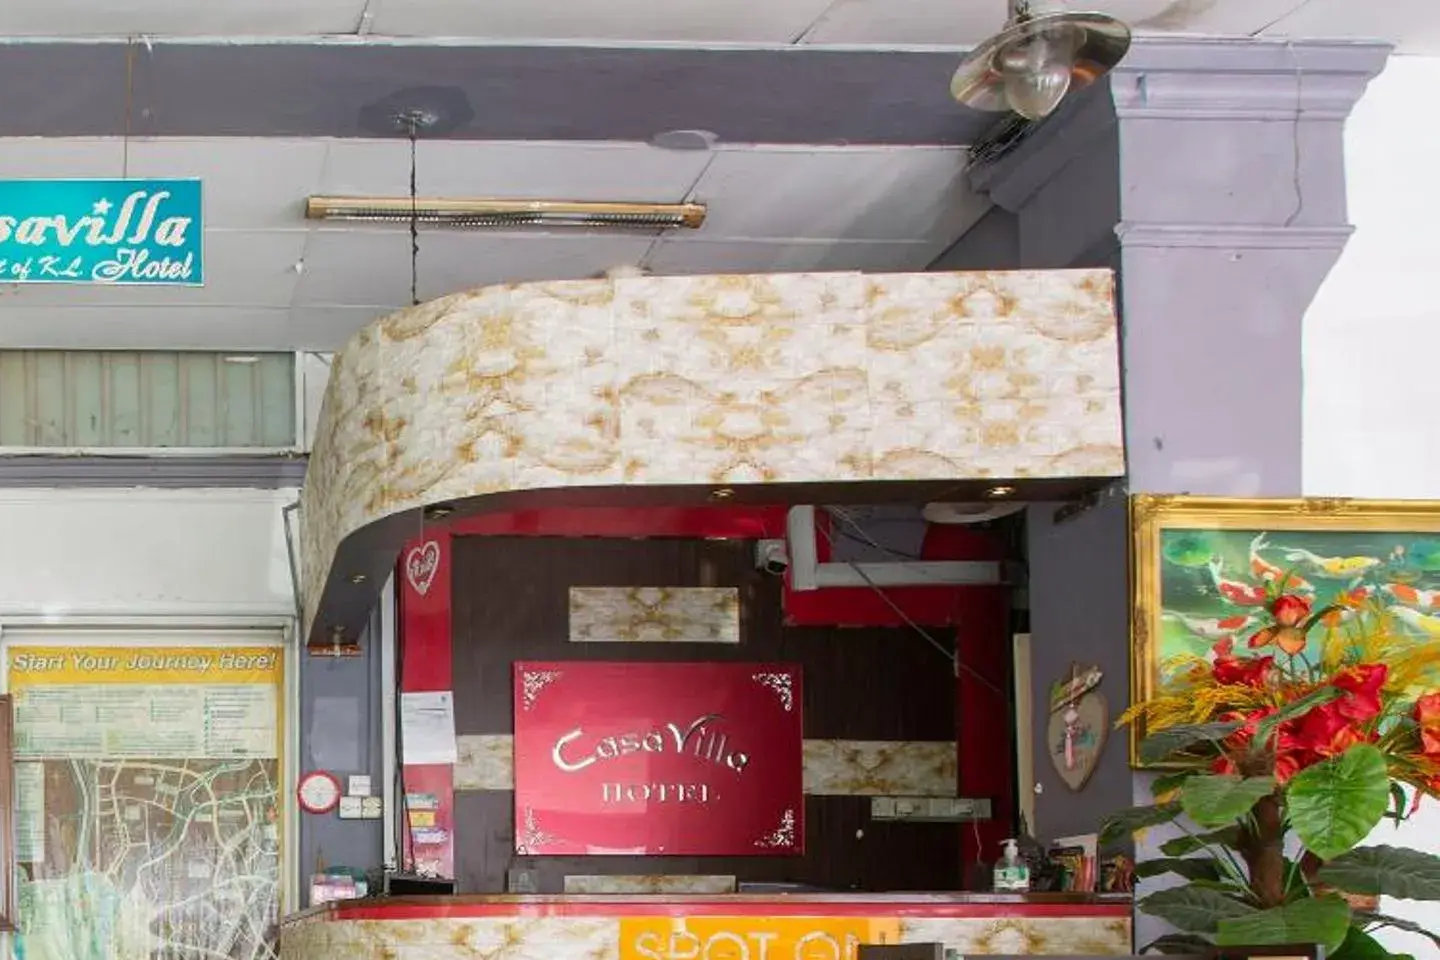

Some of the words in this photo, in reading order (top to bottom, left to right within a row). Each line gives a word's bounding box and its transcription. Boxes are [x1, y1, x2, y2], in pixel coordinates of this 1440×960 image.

[11, 257, 32, 281] of
[92, 248, 193, 281] Hotel
[14, 653, 67, 671] Start
[71, 653, 118, 671] Your
[126, 653, 212, 674] Journey
[219, 652, 277, 671] Here!
[601, 782, 720, 803] HOTEL
